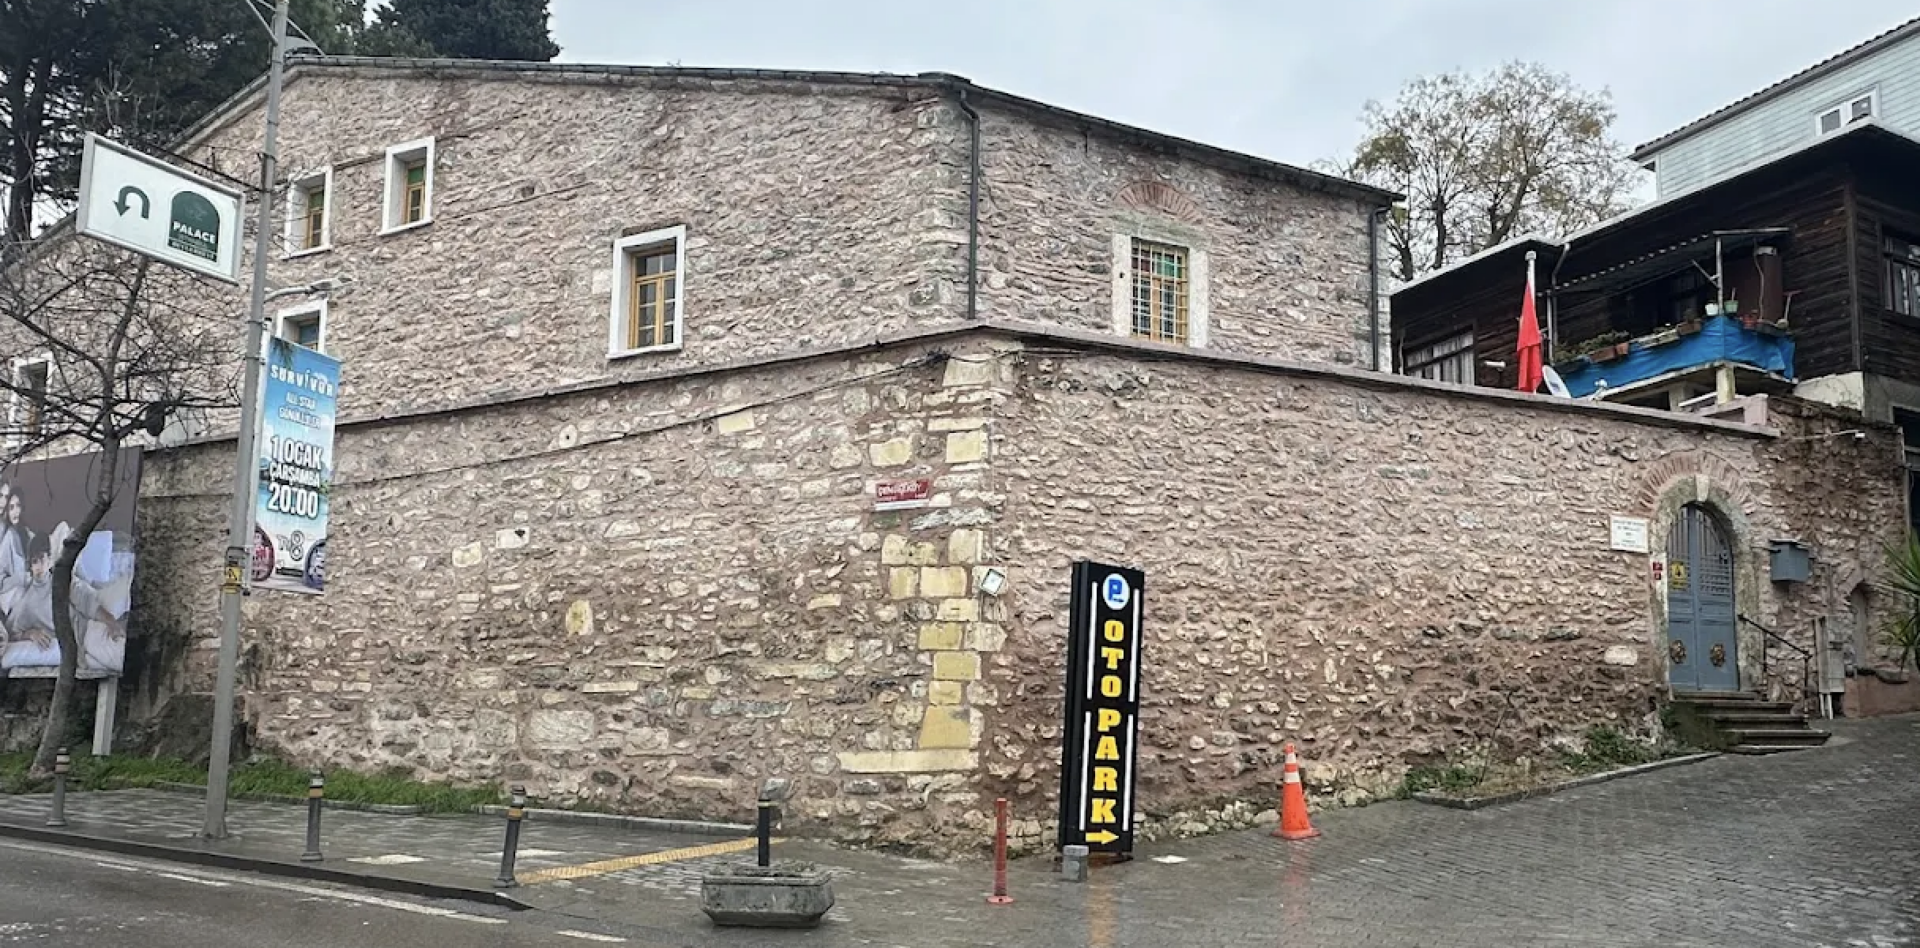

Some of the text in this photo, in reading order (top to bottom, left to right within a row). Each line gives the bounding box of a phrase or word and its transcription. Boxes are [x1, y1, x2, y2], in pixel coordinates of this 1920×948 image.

[173, 221, 215, 243] PALACE
[284, 438, 322, 470] OCAK
[269, 462, 320, 488] ÇARŞAMBA
[1090, 620, 1125, 824] OTOPARK
